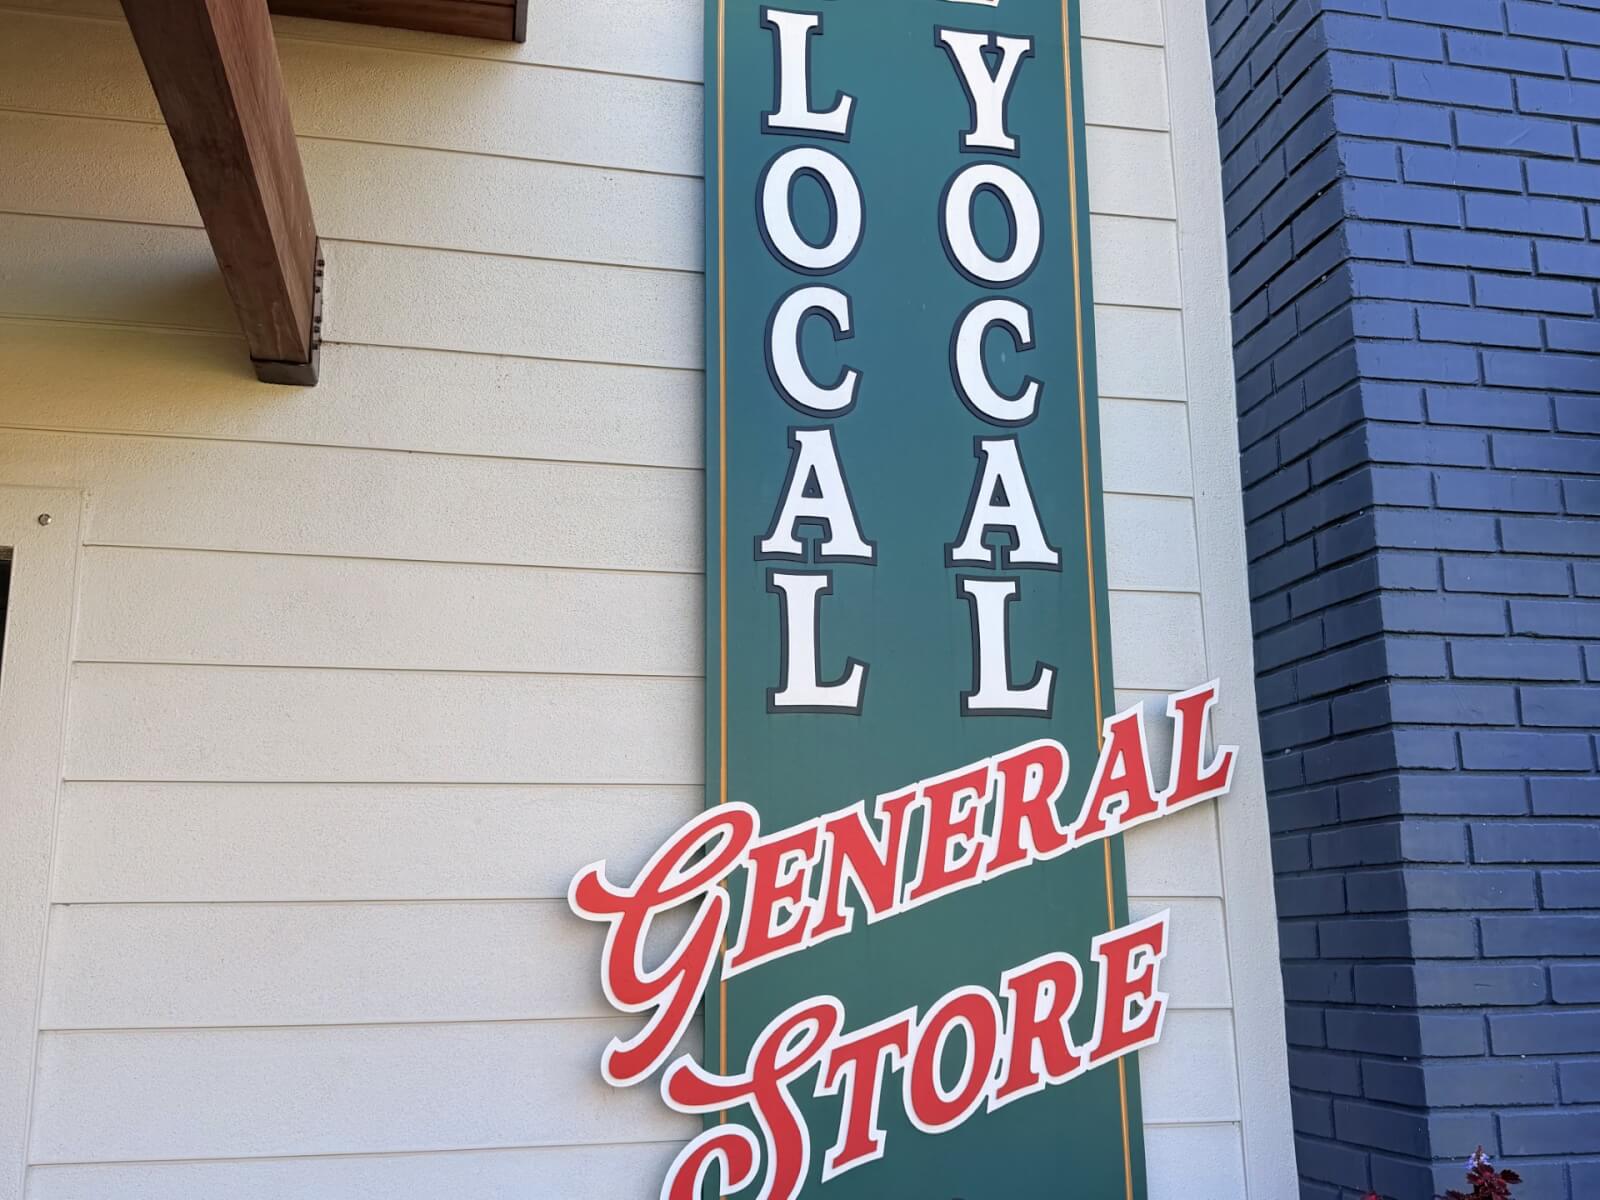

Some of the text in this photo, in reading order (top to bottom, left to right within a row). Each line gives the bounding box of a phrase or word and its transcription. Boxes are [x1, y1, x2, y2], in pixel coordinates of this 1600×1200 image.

[757, 7, 875, 712] LOCAL
[937, 27, 1060, 714] YOCAL
[570, 679, 1238, 1086] GENERAL
[662, 910, 1169, 1200] STORE
